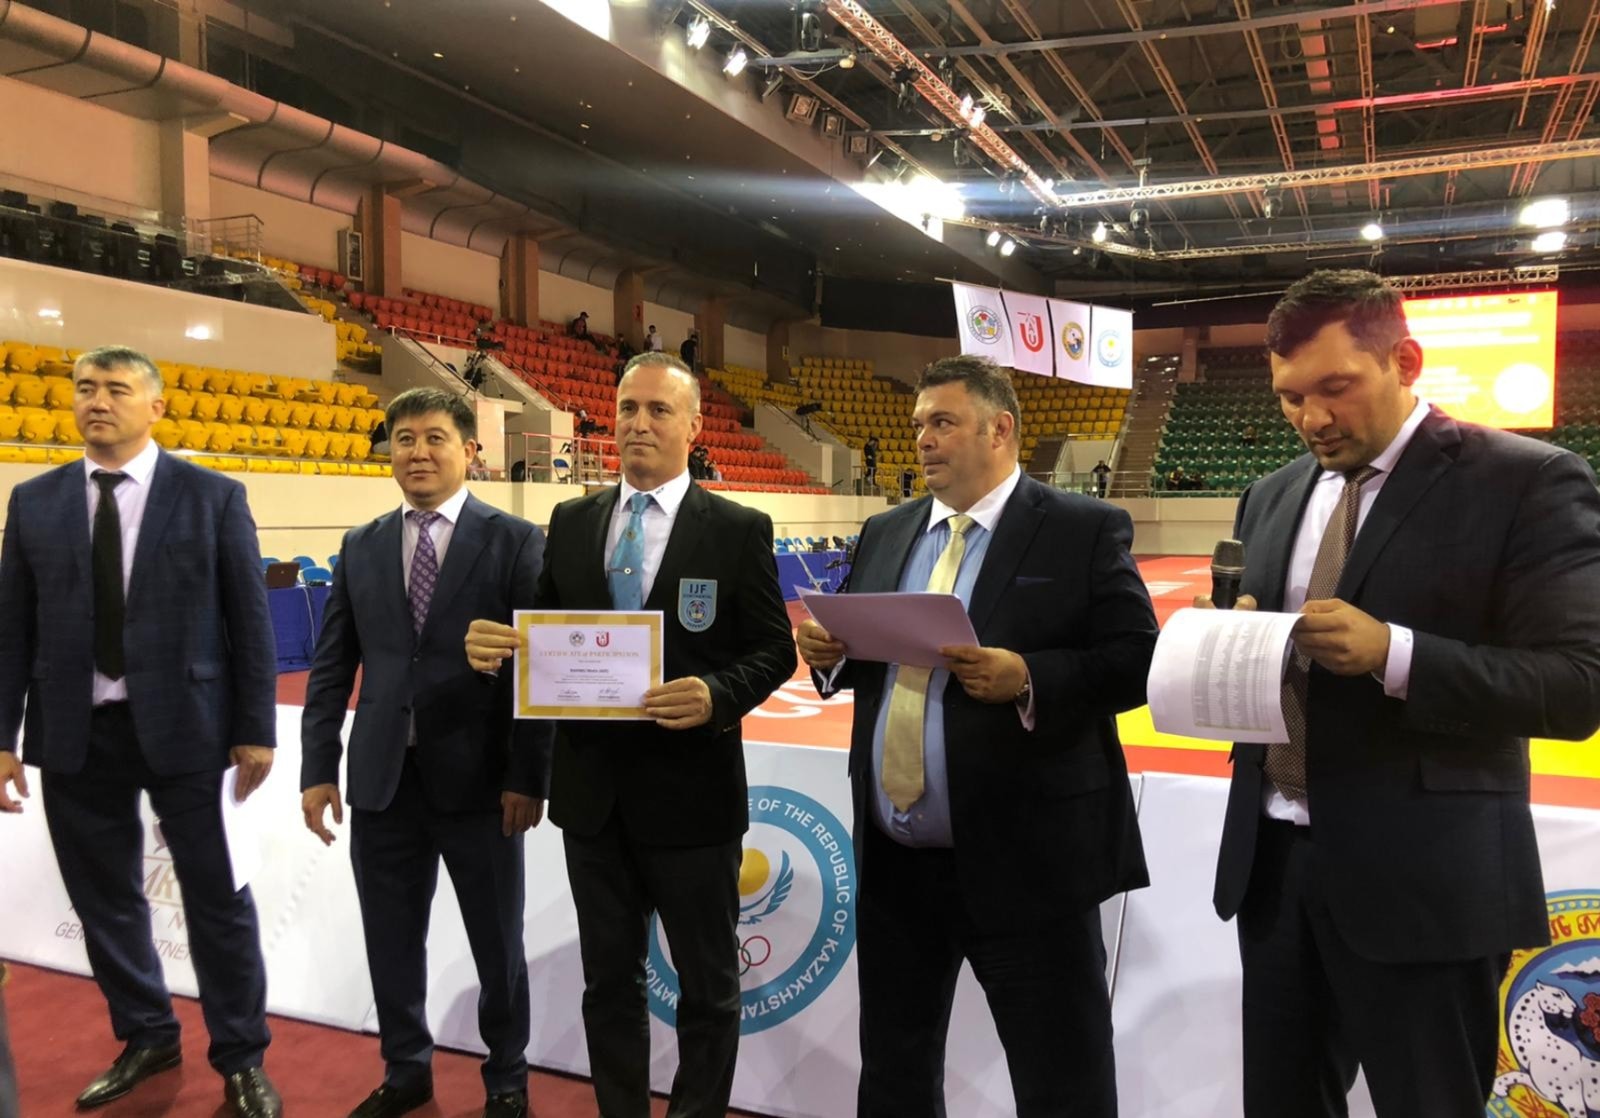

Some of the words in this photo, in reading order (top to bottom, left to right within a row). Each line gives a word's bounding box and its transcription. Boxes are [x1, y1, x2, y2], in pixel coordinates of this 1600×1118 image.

[690, 583, 707, 594] IJF
[757, 797, 782, 813] OF
[785, 803, 815, 828] THE
[811, 822, 851, 904] REPUBLIC
[832, 910, 849, 936] OF
